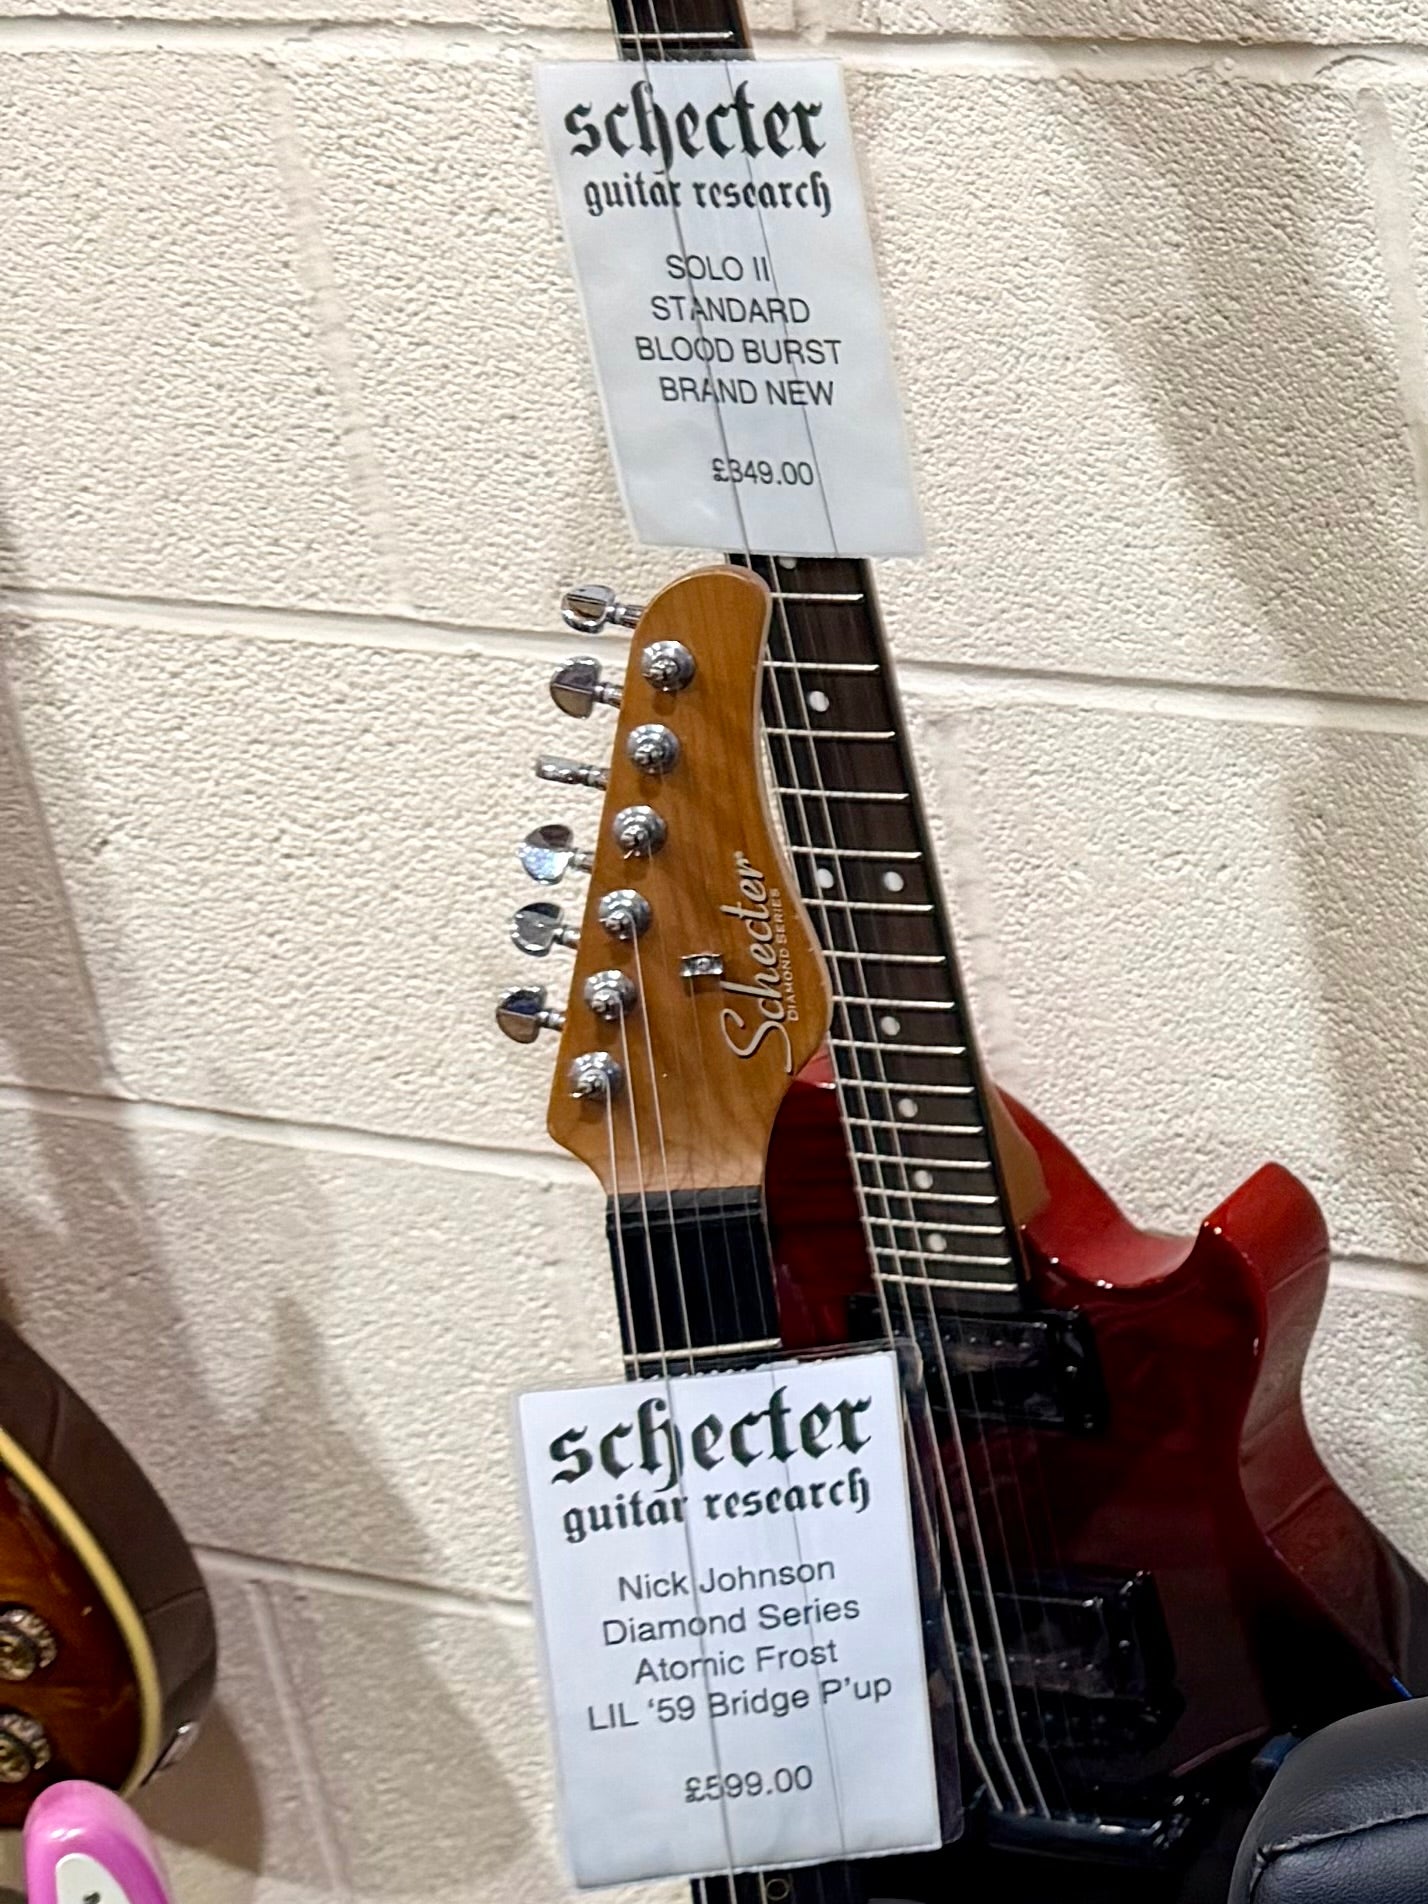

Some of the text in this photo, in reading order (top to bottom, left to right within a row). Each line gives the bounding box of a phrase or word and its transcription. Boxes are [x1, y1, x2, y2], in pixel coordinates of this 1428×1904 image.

[564, 79, 826, 174] schecter
[583, 170, 832, 218] guitar research
[666, 254, 770, 282] SOLO II
[651, 296, 810, 323] STANDARD
[635, 336, 842, 365] BLOOD BURST
[659, 377, 834, 406] BRAND NEW
[720, 854, 793, 1074] Schecter
[770, 887, 800, 1022] DIAMOND SERIES
[549, 1386, 872, 1492] schecter
[562, 1466, 871, 1544] guitar research
[618, 1560, 836, 1602] Nick Johnson
[602, 1598, 860, 1646] Diamond Series
[634, 1639, 839, 1685] Atomic Frost
[588, 1701, 639, 1731] LIL
[707, 1686, 810, 1720] Bridge
[684, 1765, 814, 1804] £599.00
